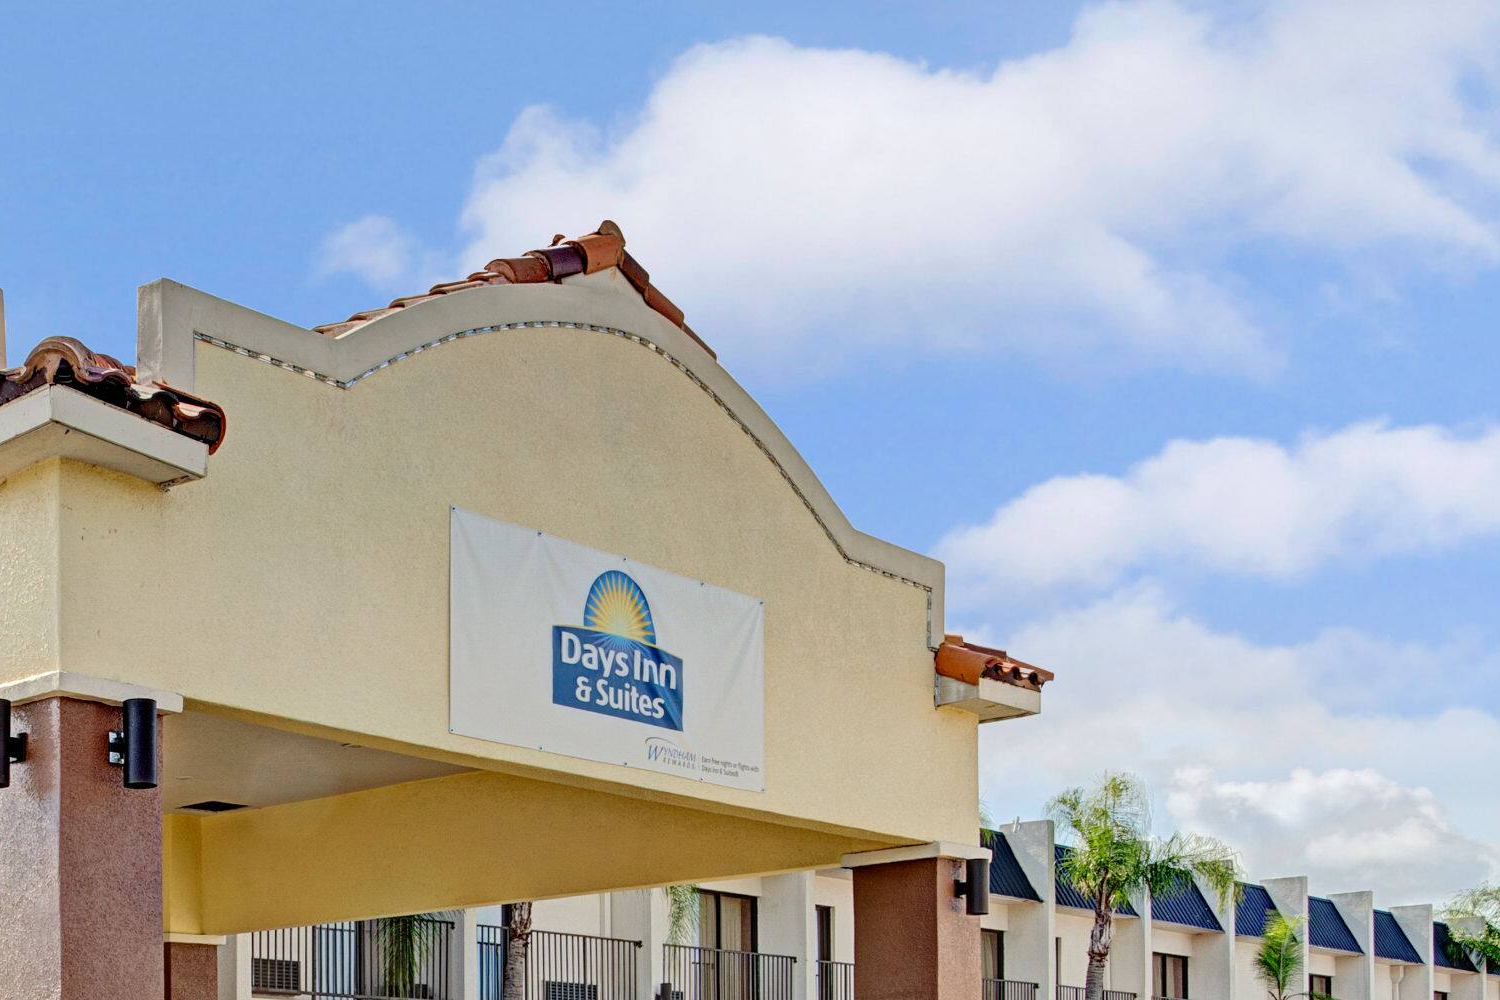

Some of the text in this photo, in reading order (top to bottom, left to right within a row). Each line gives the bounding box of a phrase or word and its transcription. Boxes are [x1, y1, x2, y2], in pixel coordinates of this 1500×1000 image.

[561, 631, 676, 689] Days Inn
[575, 676, 664, 718] & Suites
[648, 745, 697, 762] WYNDHAM
